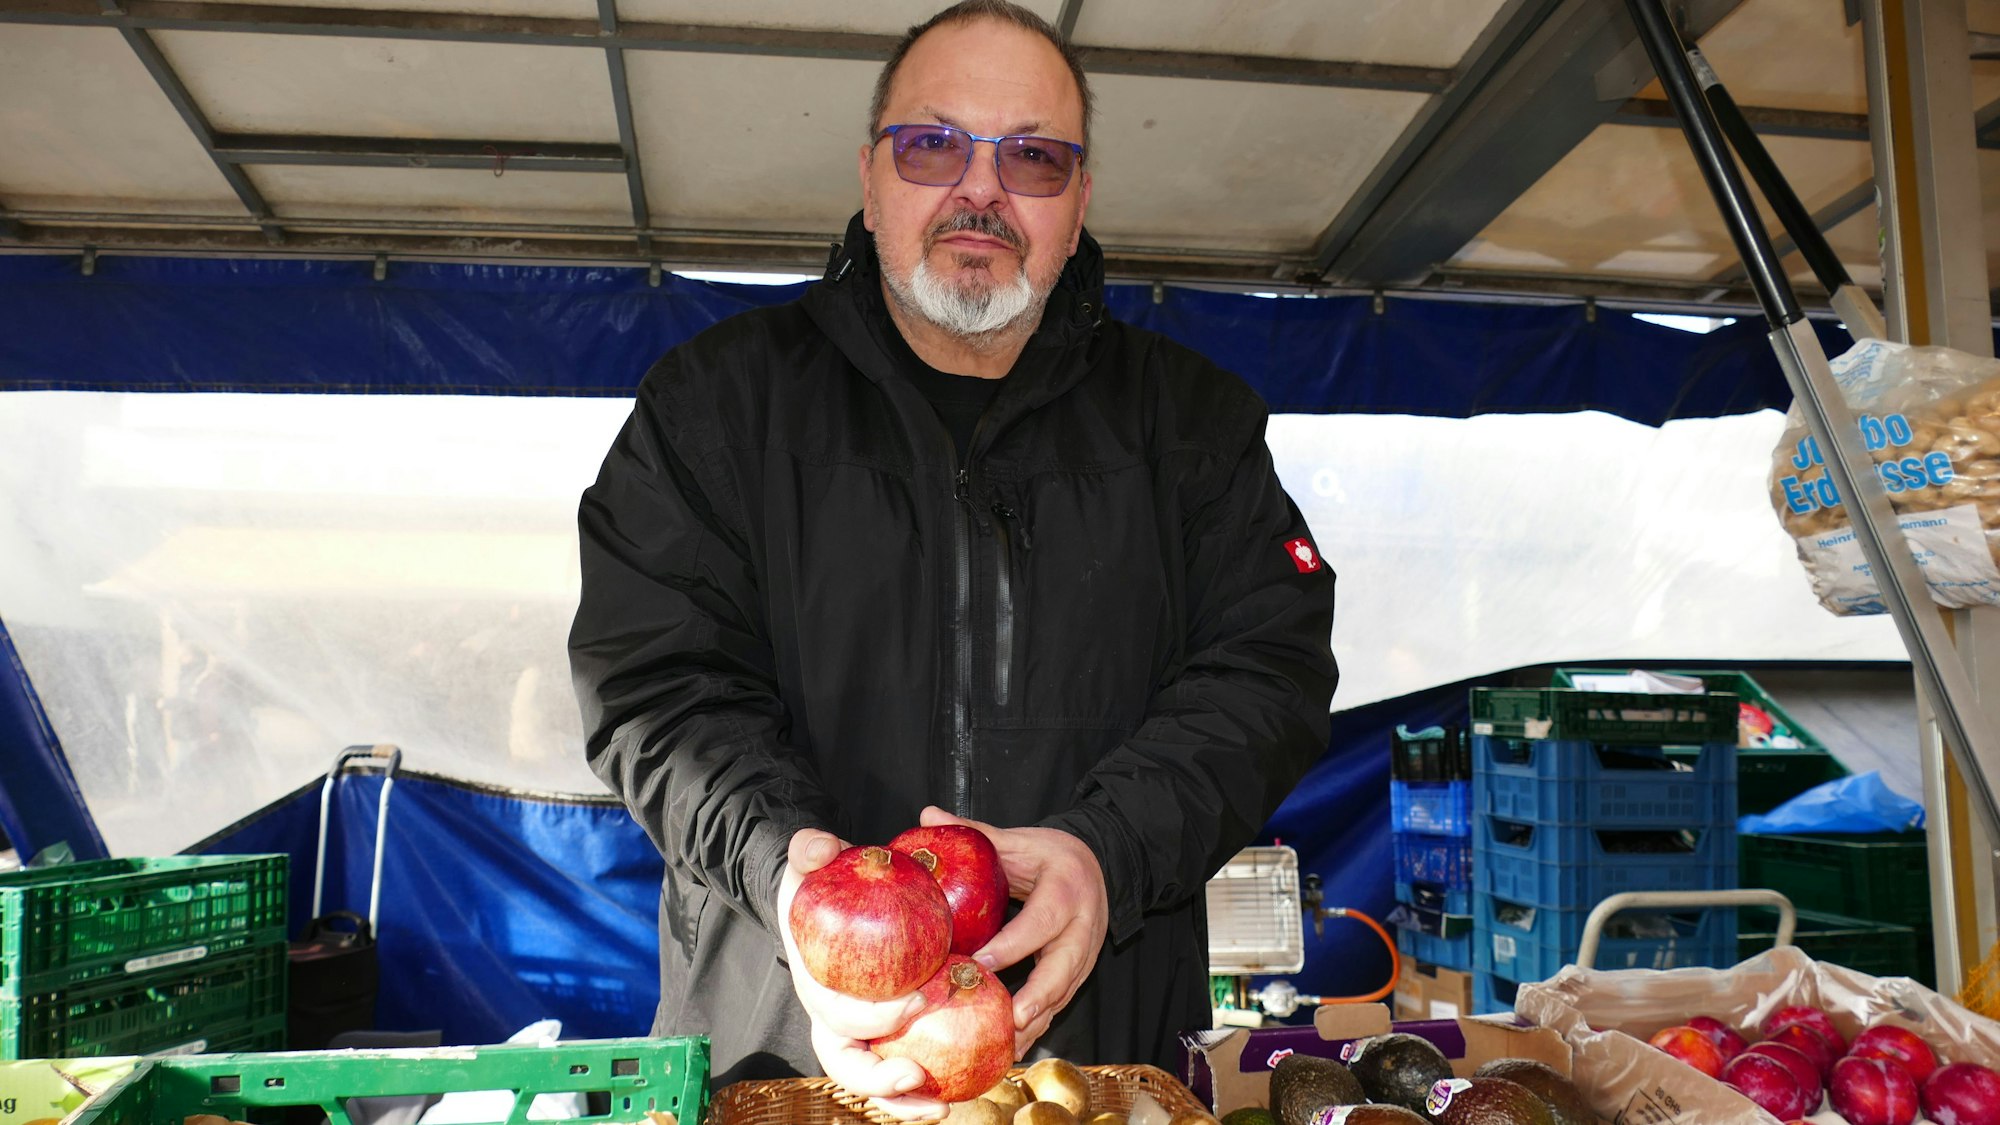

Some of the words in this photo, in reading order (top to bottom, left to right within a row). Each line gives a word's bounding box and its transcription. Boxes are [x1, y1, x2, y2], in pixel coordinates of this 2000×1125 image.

[1793, 414, 1912, 469] Jbo
[1781, 452, 1953, 513] Erdsse
[1817, 529, 1857, 548] Heinri
[1899, 518, 1948, 529] emann
